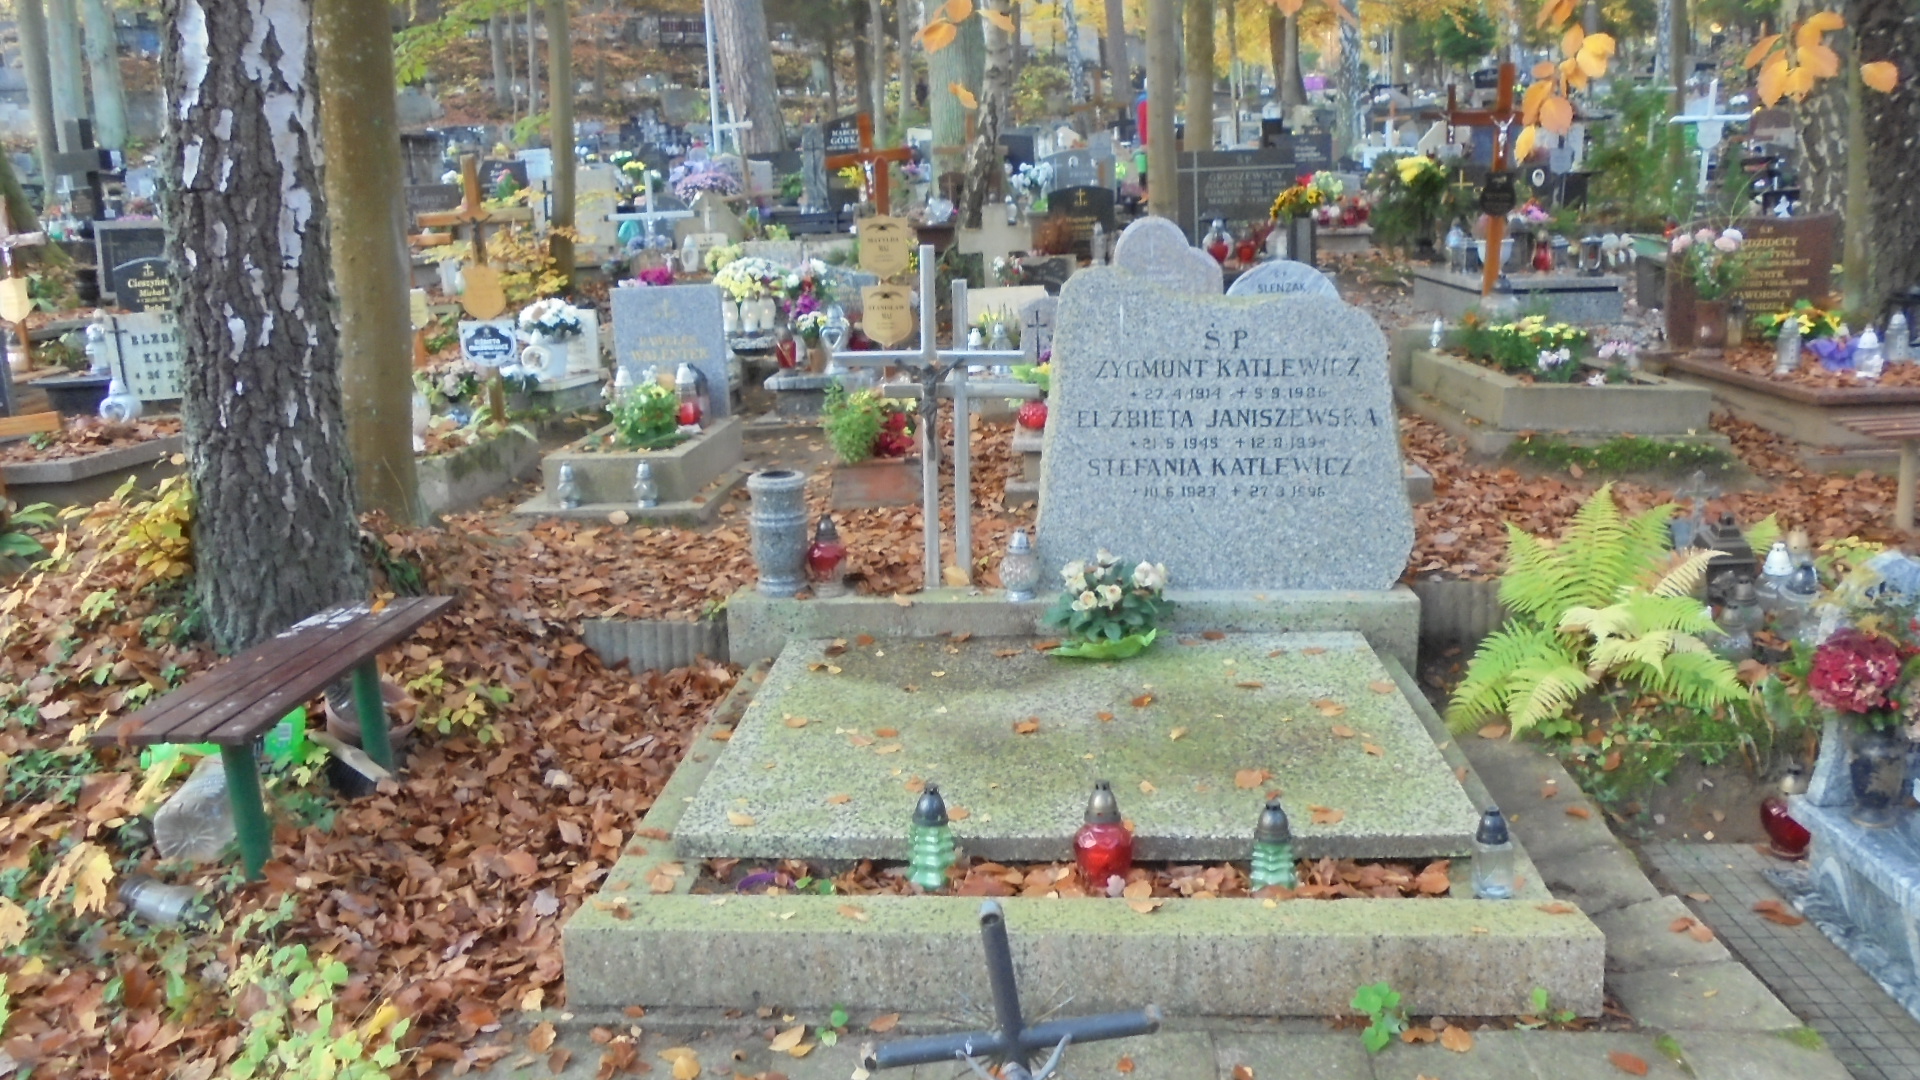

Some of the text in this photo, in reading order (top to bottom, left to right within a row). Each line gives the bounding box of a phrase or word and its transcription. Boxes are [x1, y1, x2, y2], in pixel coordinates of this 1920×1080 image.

[1095, 357, 1361, 379] ZYGMUNT KATLEWICZ
[1087, 456, 1355, 478] STEFANIA KATLEWICZ
